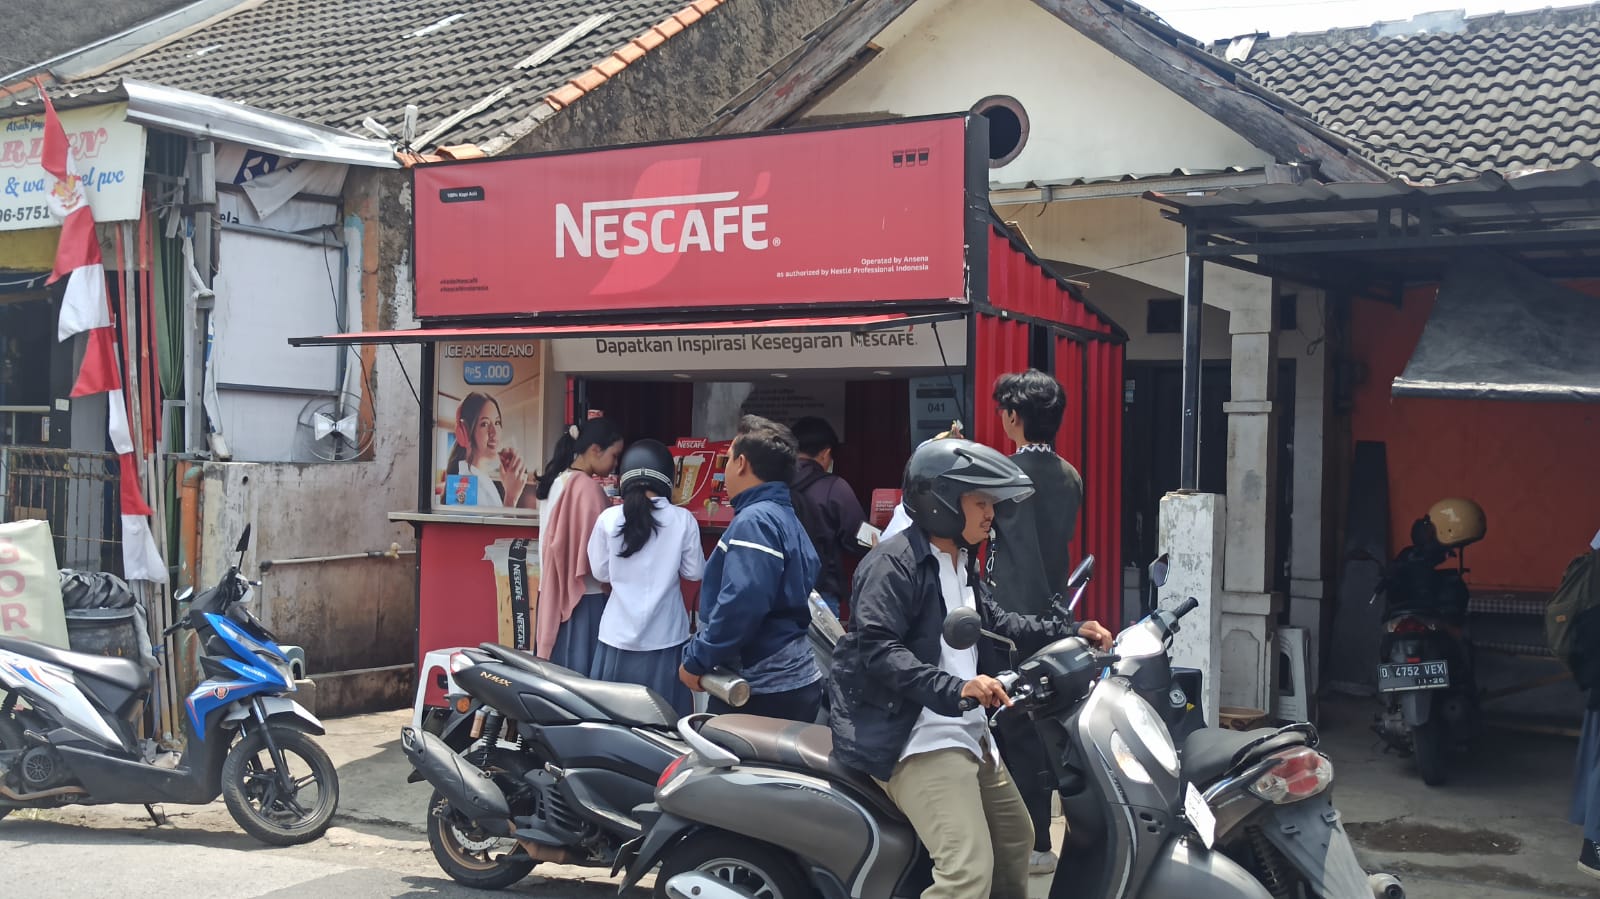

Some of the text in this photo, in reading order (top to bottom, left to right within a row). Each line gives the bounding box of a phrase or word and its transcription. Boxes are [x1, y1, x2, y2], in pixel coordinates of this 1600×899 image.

[5, 176, 20, 198] &
[97, 170, 125, 192] pvc
[861, 256, 892, 266] Operated
[893, 256, 902, 265] by
[785, 269, 820, 278] authorized
[821, 269, 829, 277] by
[853, 265, 895, 275] Professional
[896, 263, 929, 272] Indonesia
[445, 343, 534, 358] ICE AMERICANO
[596, 337, 673, 356] Dapatkan
[677, 334, 747, 355] Inspirasi
[751, 333, 843, 353] Kesegaran
[927, 402, 945, 414] 041
[1381, 663, 1444, 678] D 4752 VEX
